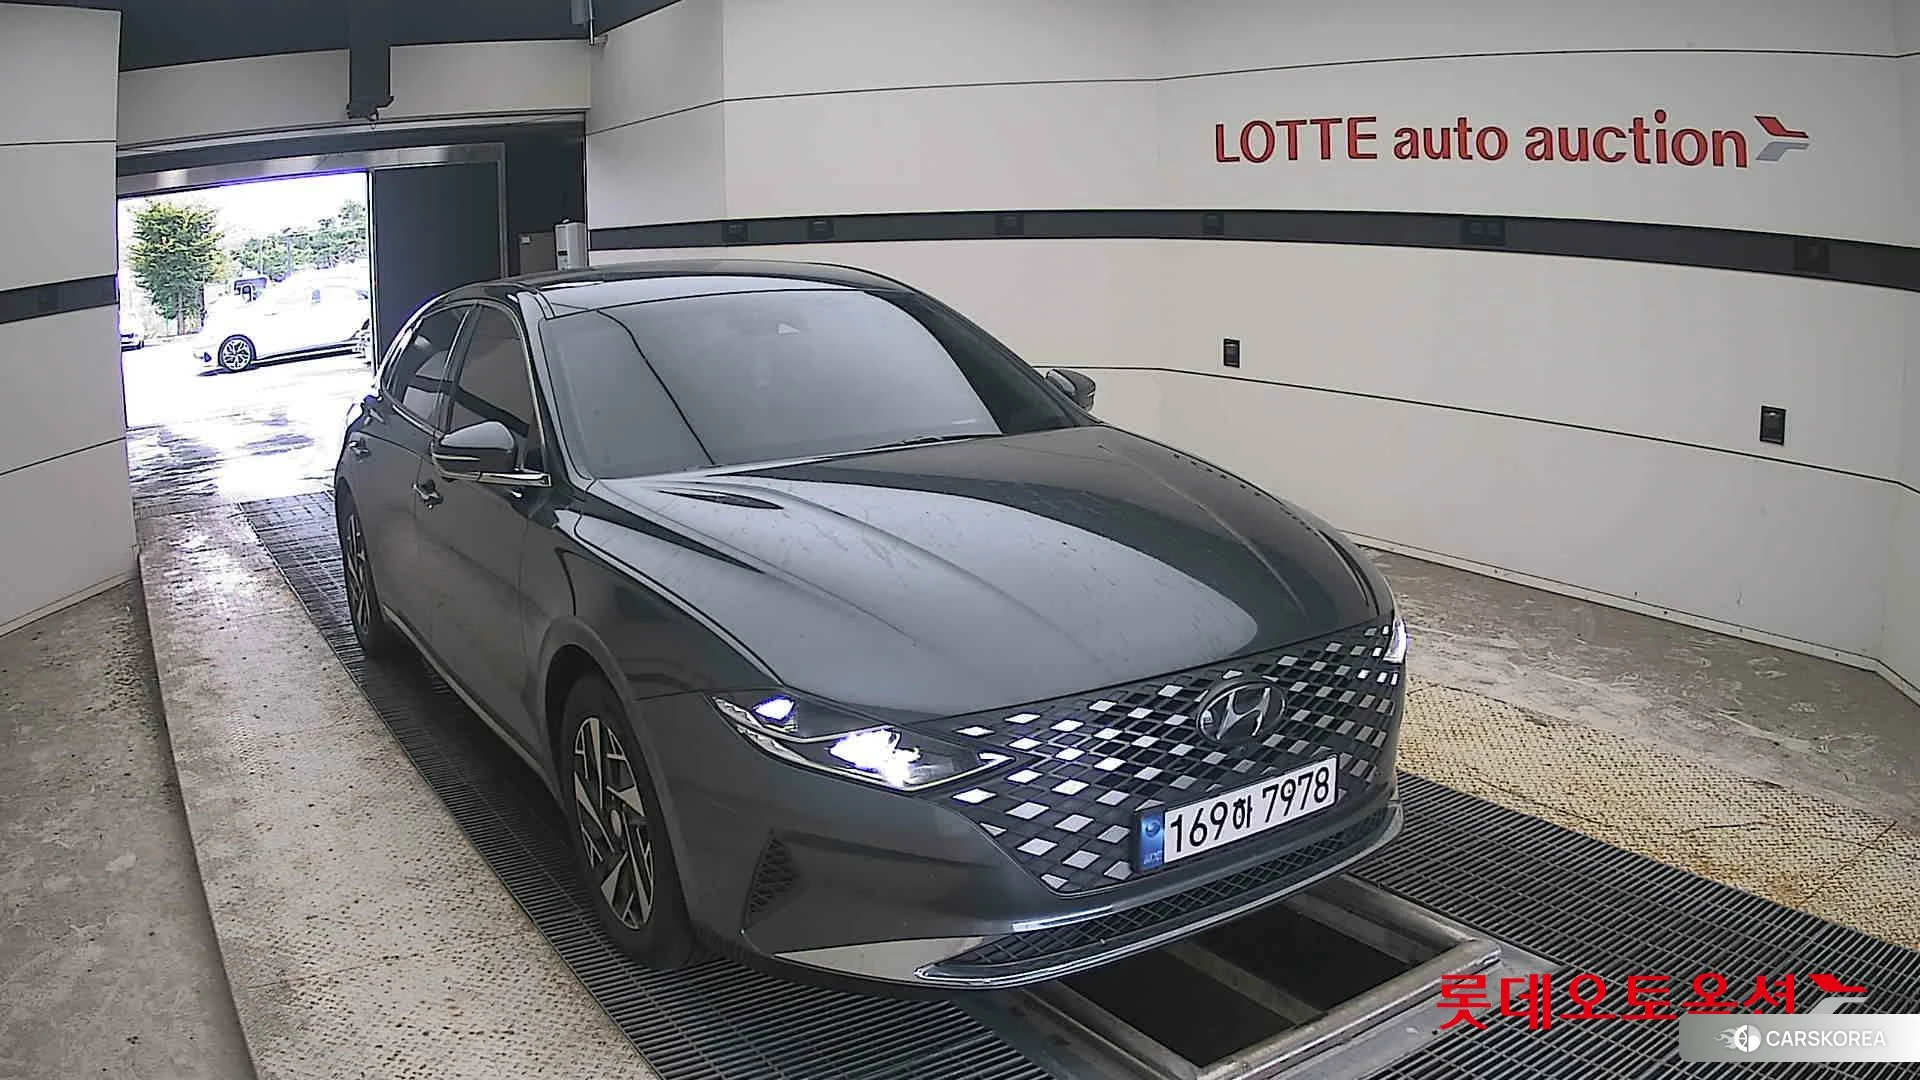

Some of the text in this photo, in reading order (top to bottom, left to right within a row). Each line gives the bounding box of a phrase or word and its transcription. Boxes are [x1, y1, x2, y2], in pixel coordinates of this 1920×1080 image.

[1215, 109, 1748, 168] LOTTE auto auction
[1170, 766, 1330, 852] 169하 7978
